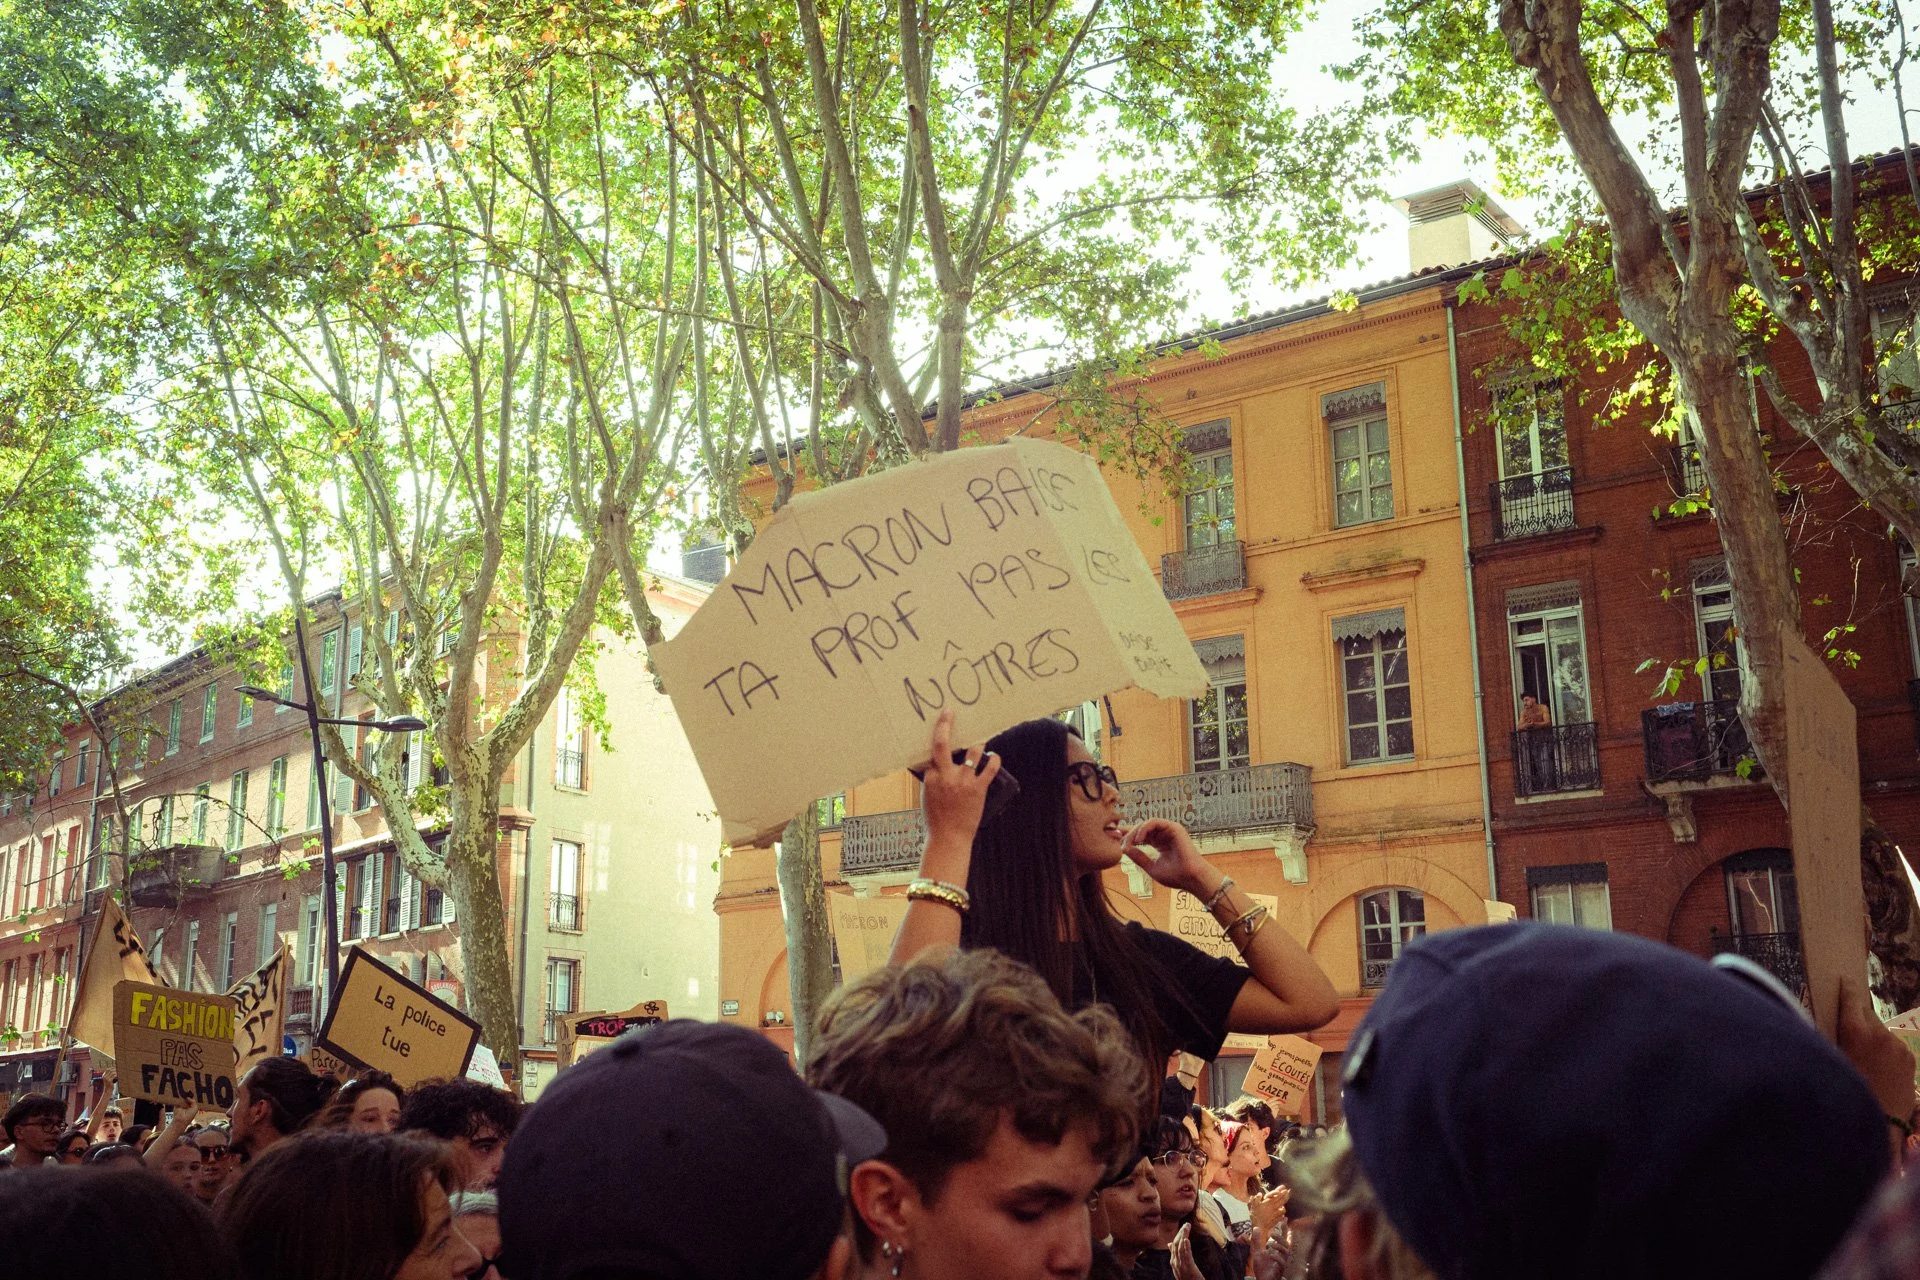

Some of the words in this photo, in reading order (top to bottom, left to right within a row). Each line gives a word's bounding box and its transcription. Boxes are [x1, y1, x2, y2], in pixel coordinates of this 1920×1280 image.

[731, 502, 952, 625] MACRON
[966, 466, 1079, 532] BAISE
[703, 660, 780, 717] TA
[810, 591, 921, 679] PROF
[958, 547, 1071, 619] PAS
[902, 627, 1080, 722] NÔTRES
[373, 985, 394, 1011] La
[401, 1005, 447, 1037] police
[589, 1018, 626, 1036] TROP
[160, 1038, 204, 1071] PAS
[381, 1025, 411, 1058] tue
[141, 1063, 235, 1109] FACHO
[1257, 1080, 1289, 1100] GAZER
